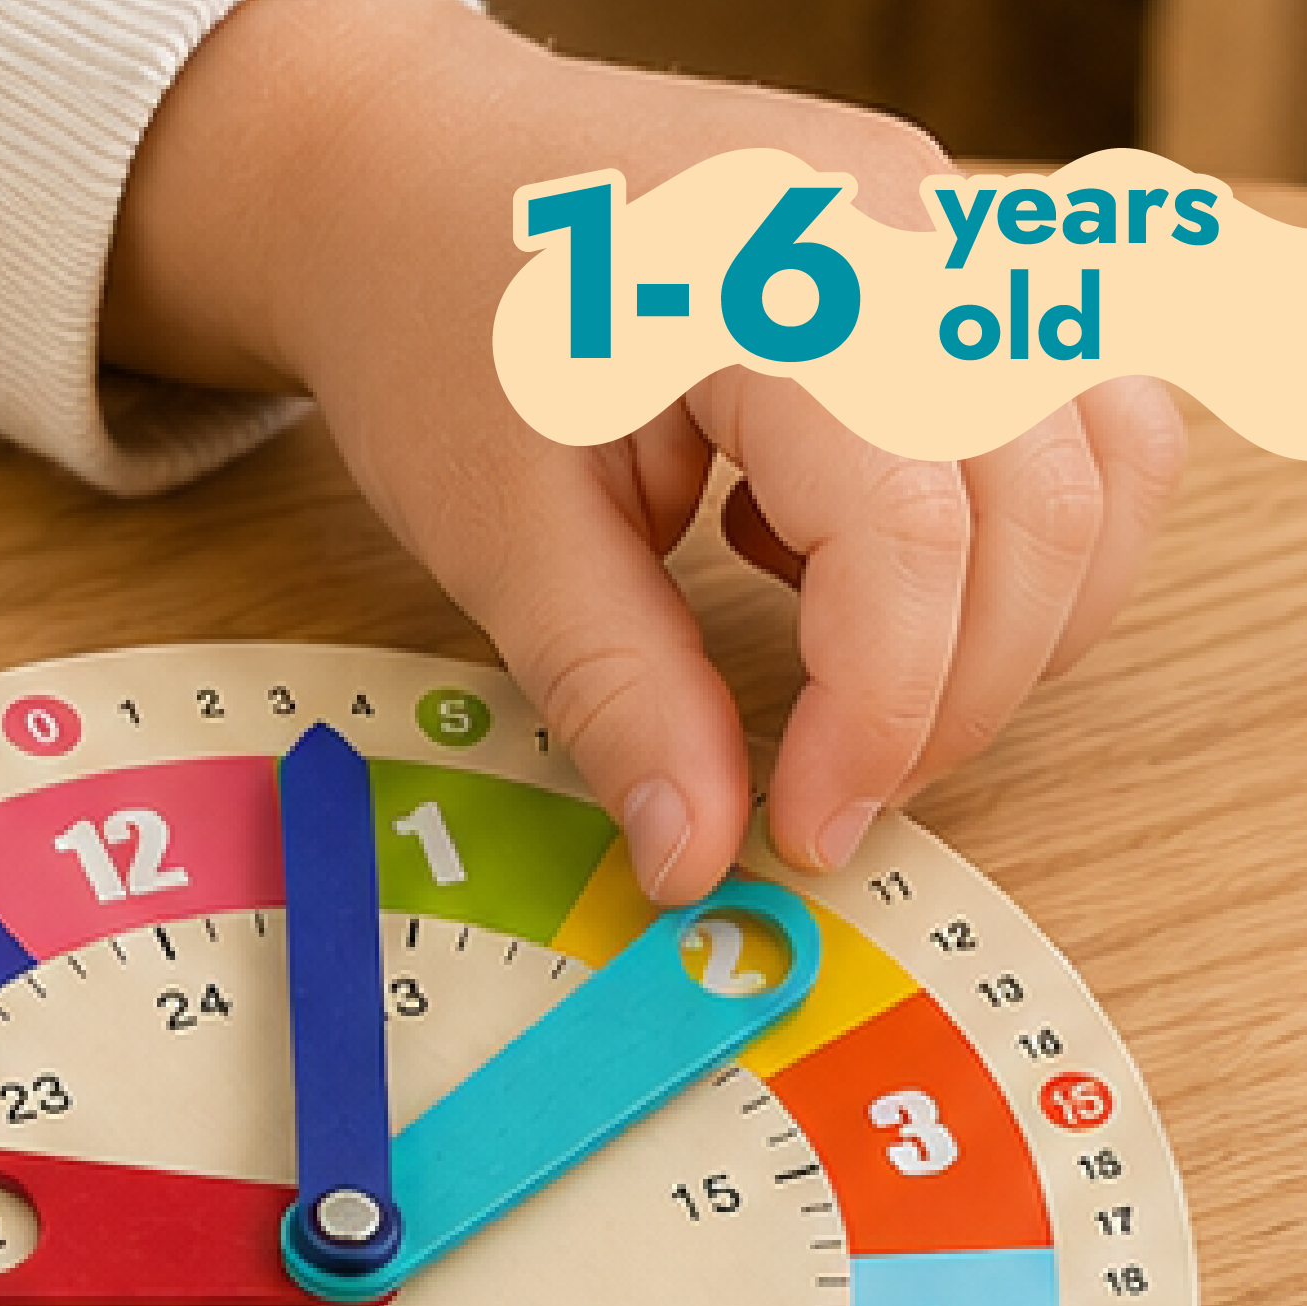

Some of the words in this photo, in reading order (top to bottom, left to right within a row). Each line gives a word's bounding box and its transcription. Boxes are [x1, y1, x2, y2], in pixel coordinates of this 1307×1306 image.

[119, 698, 141, 725] 1
[195, 688, 226, 720] 2
[266, 684, 297, 716] 3
[26, 707, 61, 744] 0
[55, 811, 188, 900] 12
[392, 802, 464, 886] 1
[870, 870, 910, 902] 11
[928, 921, 977, 953] 12
[681, 920, 767, 998] 2
[156, 983, 229, 1031] 24
[868, 1091, 957, 1175] 3
[671, 1174, 740, 1222] 15
[1097, 1205, 1132, 1237] 17
